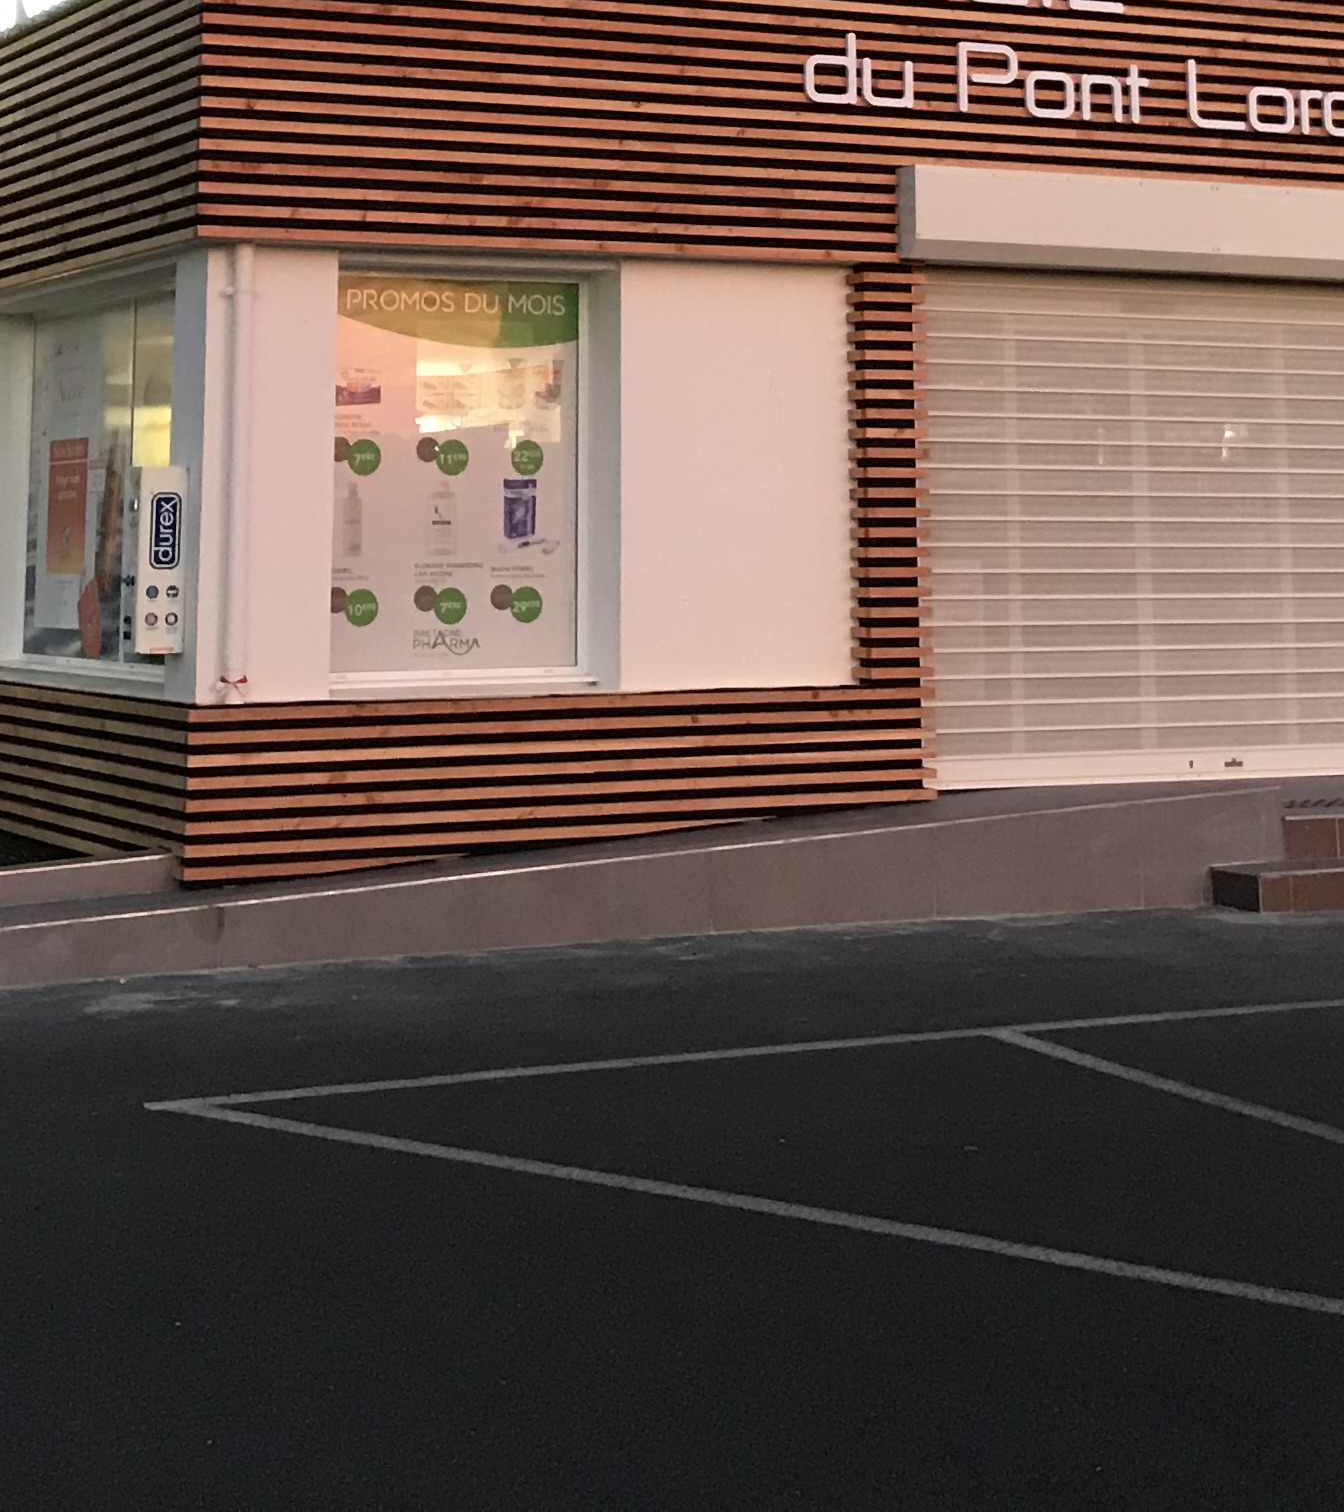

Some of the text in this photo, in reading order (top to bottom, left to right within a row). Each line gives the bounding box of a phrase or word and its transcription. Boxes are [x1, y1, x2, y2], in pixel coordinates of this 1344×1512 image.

[804, 31, 915, 109] du
[957, 40, 1150, 124] Pont
[346, 288, 567, 317] PROMOS DU MOIS
[153, 495, 179, 563] durex
